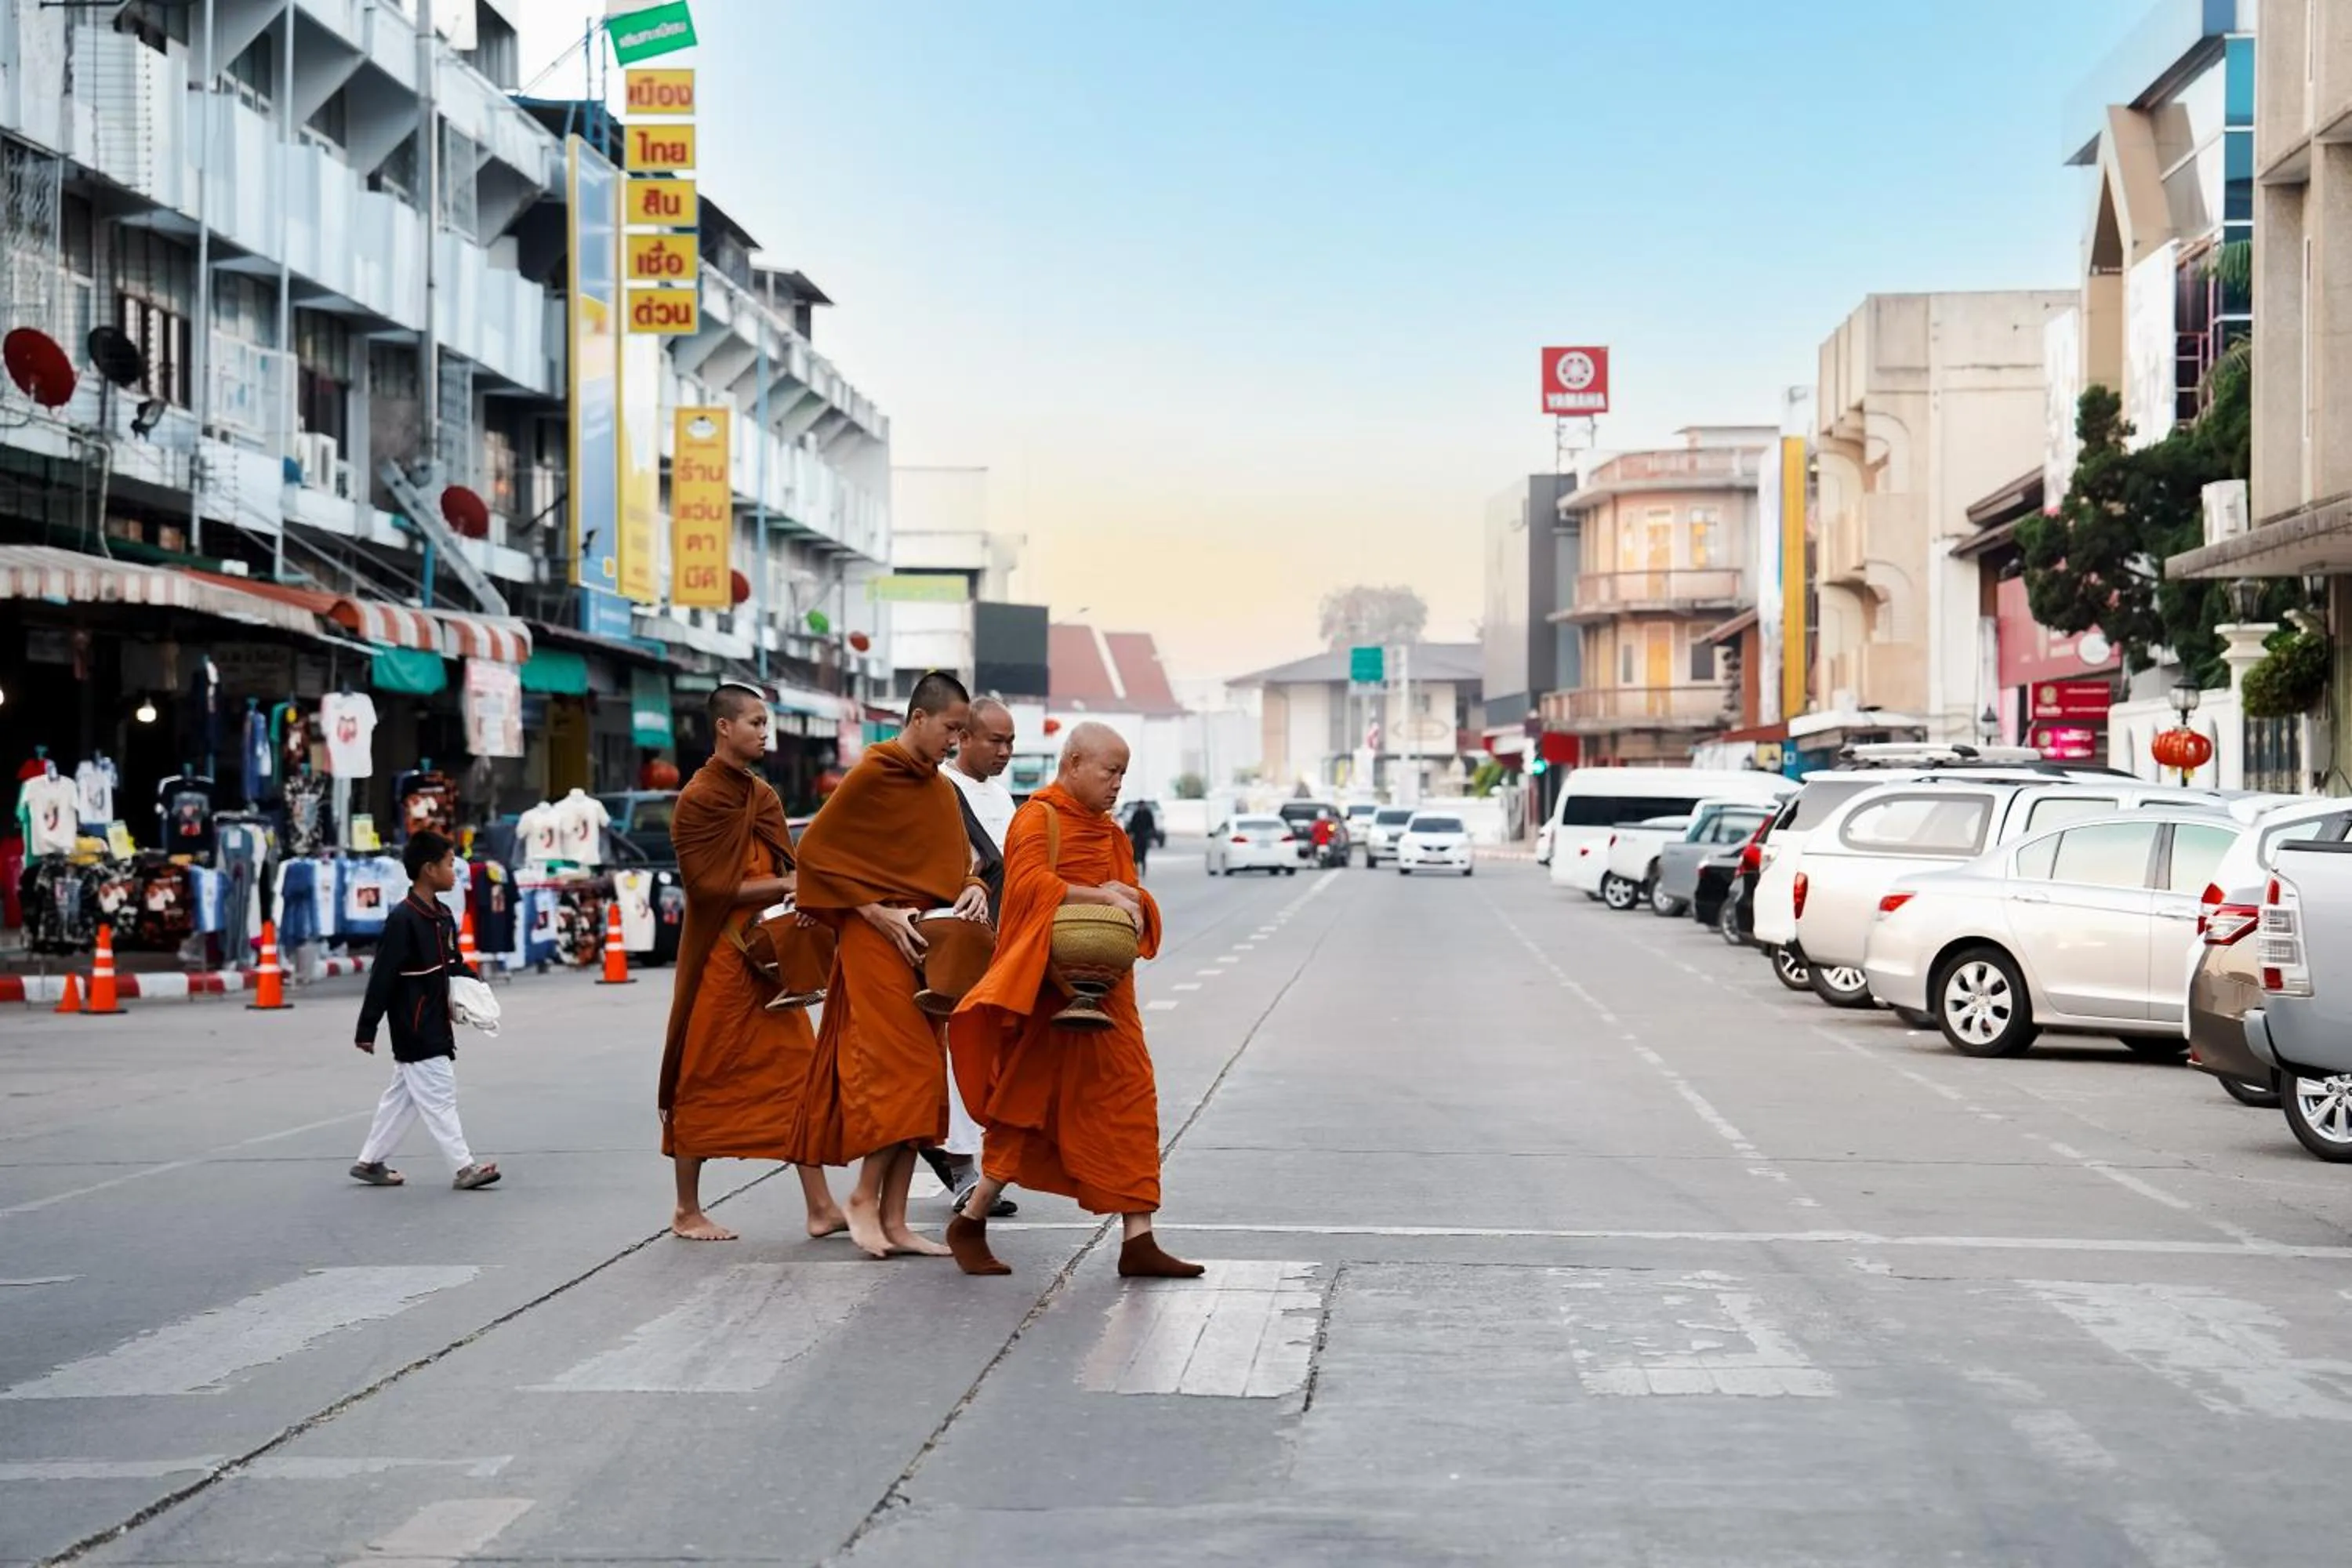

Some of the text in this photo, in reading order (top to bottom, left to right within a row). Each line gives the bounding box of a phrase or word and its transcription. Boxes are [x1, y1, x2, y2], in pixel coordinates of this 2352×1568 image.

[636, 130, 686, 164] ไทย
[643, 188, 681, 216] สิน
[637, 238, 684, 276] เชื่อ
[634, 295, 691, 325] ด่วน
[680, 456, 724, 482] ร้าน
[679, 495, 723, 521] แว่น
